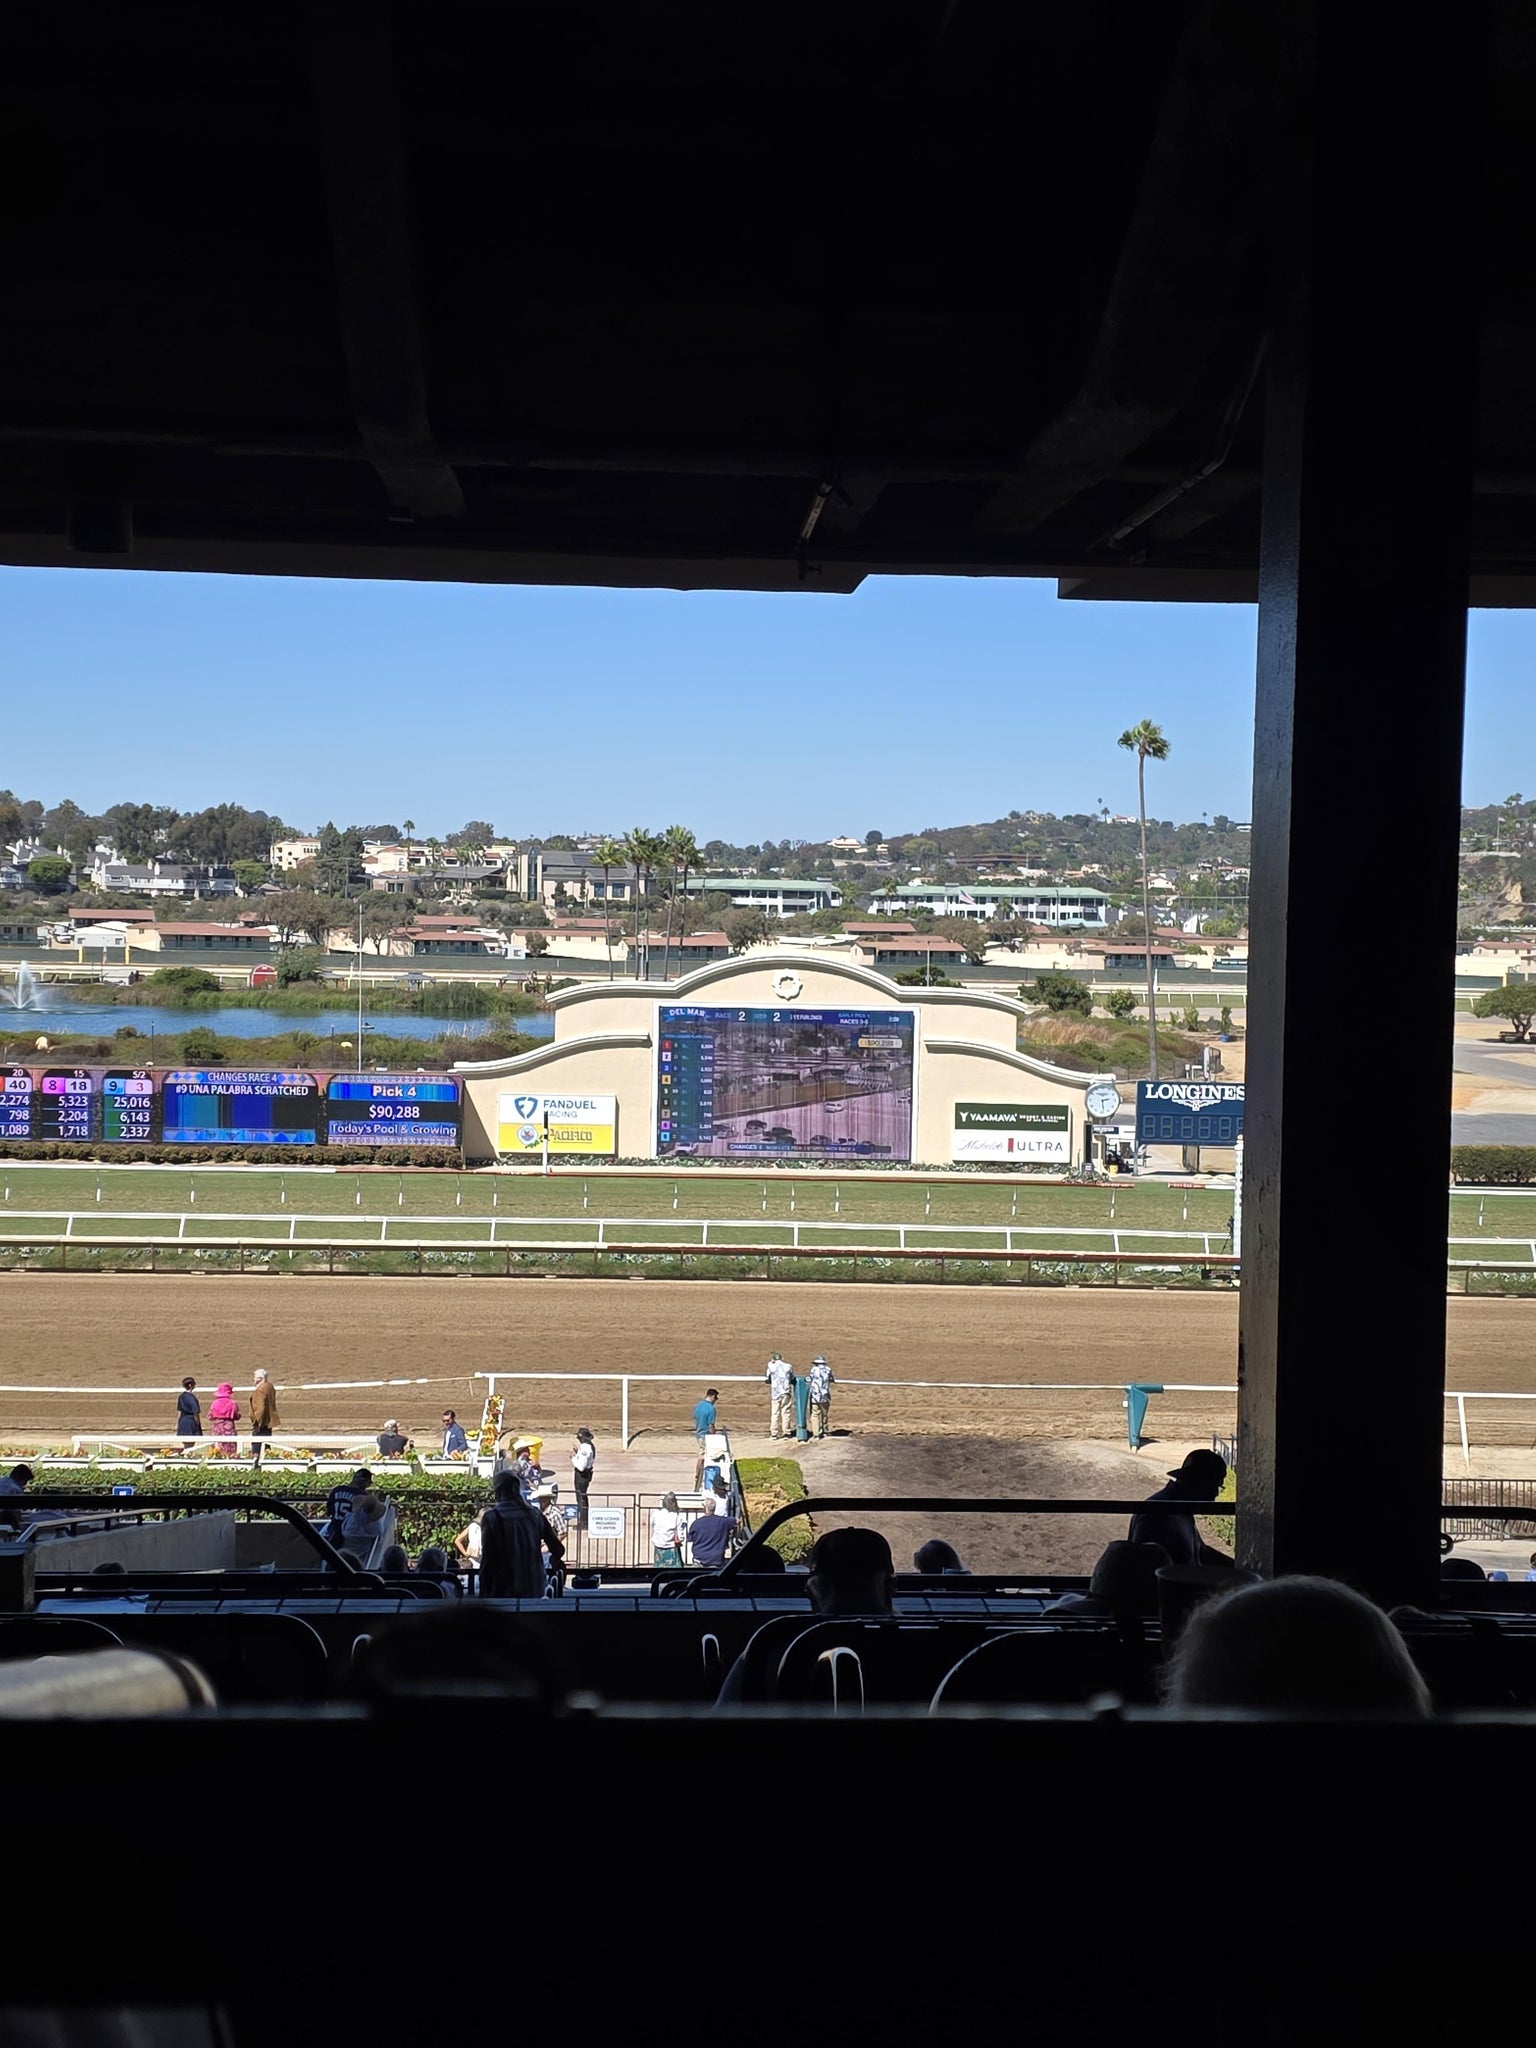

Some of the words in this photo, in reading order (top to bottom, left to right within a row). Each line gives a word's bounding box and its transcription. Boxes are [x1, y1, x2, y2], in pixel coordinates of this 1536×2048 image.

[669, 1008, 685, 1016] DEL
[687, 1008, 705, 1017] MAR
[738, 1011, 746, 1021] 2
[773, 1012, 781, 1022] 2
[12, 1069, 24, 1077] 20
[73, 1070, 85, 1078] 15
[132, 1071, 147, 1079] 5/2
[207, 1072, 248, 1081] CHANGES
[250, 1073, 270, 1082] RACE
[271, 1074, 277, 1082] 4
[9, 1080, 27, 1090] 40
[48, 1080, 57, 1090] 8
[70, 1081, 87, 1091] 18
[109, 1081, 118, 1091] 9
[136, 1082, 144, 1092] 3
[176, 1084, 187, 1093] #9
[189, 1085, 209, 1094] UNA
[211, 1085, 253, 1095] PALABRA
[254, 1086, 309, 1096] SCRATCHED
[372, 1085, 403, 1097] Pick
[407, 1086, 417, 1097] 4
[1145, 1083, 1245, 1101] LONGINES
[0, 1095, 30, 1107] 2,274
[58, 1096, 88, 1108] 5,323
[114, 1097, 151, 1109] 25,016
[543, 1100, 597, 1109] FANDUEL
[9, 1110, 30, 1120] 798
[58, 1111, 88, 1123] 2,204
[369, 1104, 420, 1120] $90,288
[120, 1112, 150, 1124] 6,143
[0, 1125, 30, 1137] 1,089
[58, 1126, 88, 1138] 1,718
[120, 1127, 150, 1138] 2,337
[332, 1123, 372, 1136] Today's
[374, 1124, 398, 1134] Pool
[400, 1125, 408, 1134] &
[411, 1125, 457, 1137] Growing
[1017, 1142, 1063, 1152] ULTRA
[334, 1501, 351, 1519] 15
